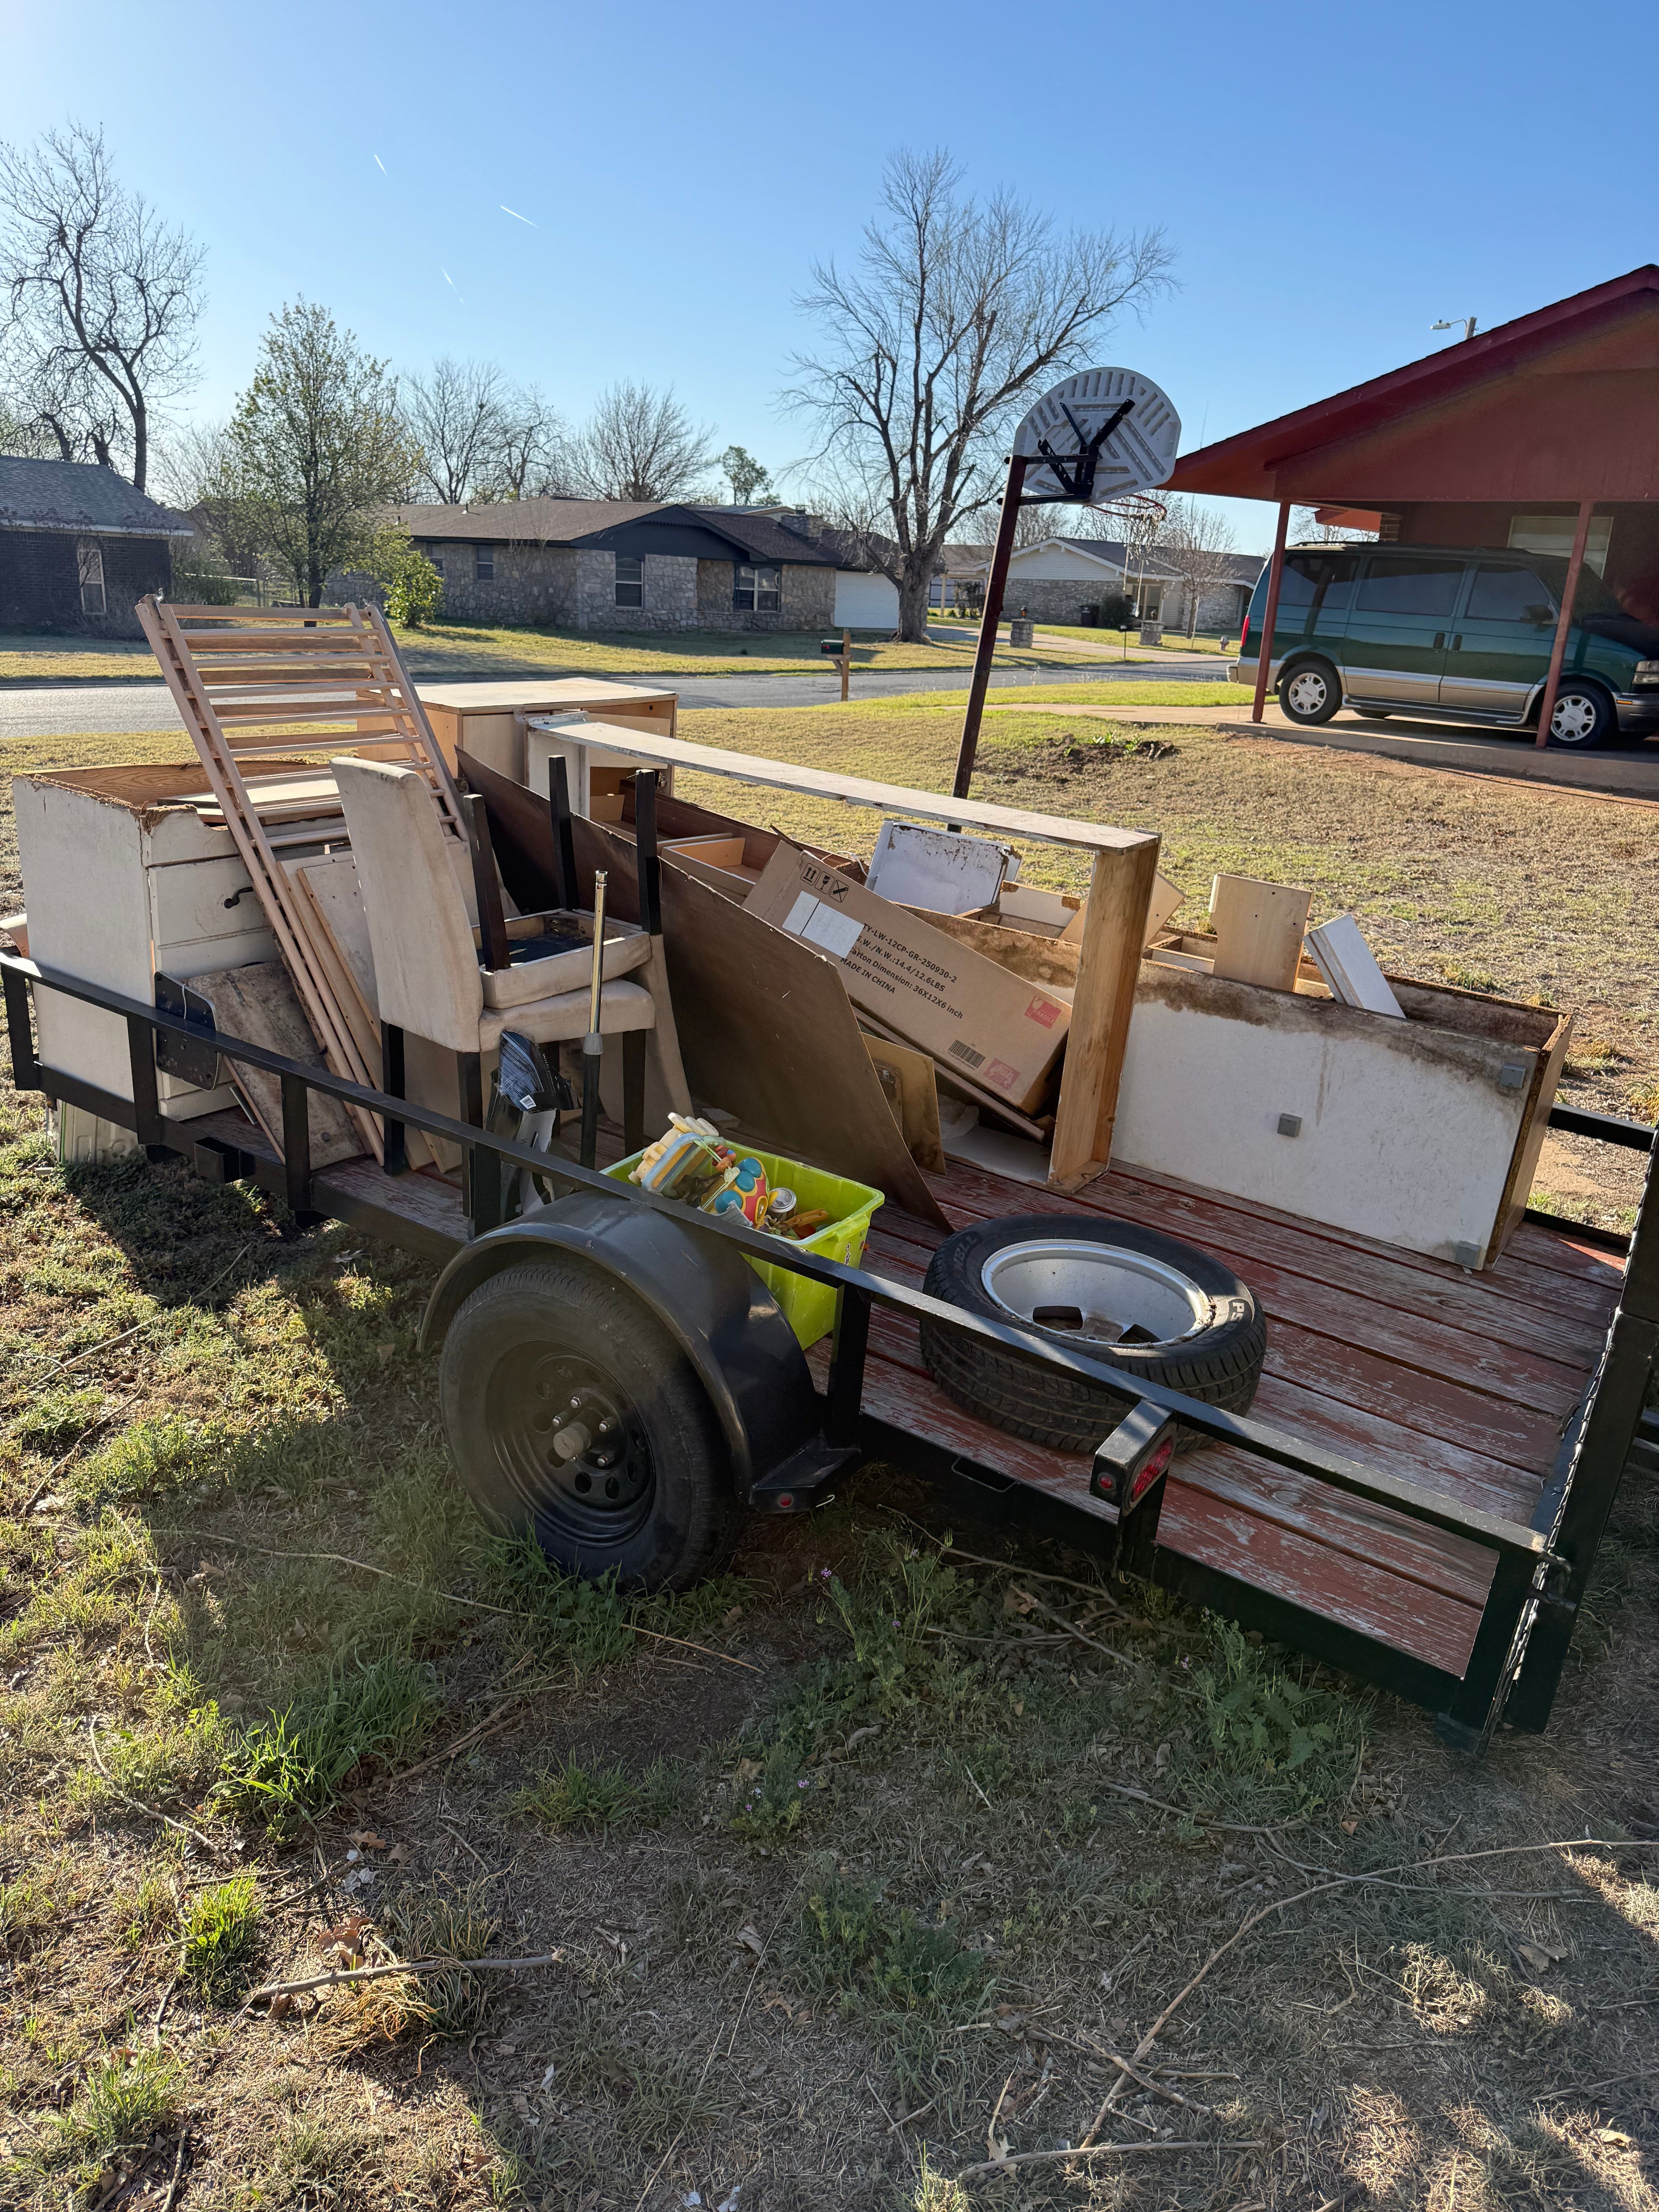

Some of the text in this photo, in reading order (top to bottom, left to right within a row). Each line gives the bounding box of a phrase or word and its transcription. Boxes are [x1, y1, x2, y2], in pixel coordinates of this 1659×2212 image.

[840, 958, 895, 994] MADE IN CHINA
[863, 923, 957, 983] TY-LW-12CP-GR-250930-2
[850, 947, 963, 1019] arton Dimension: 36X12X6 inch
[1196, 1302, 1244, 1345] PS830
